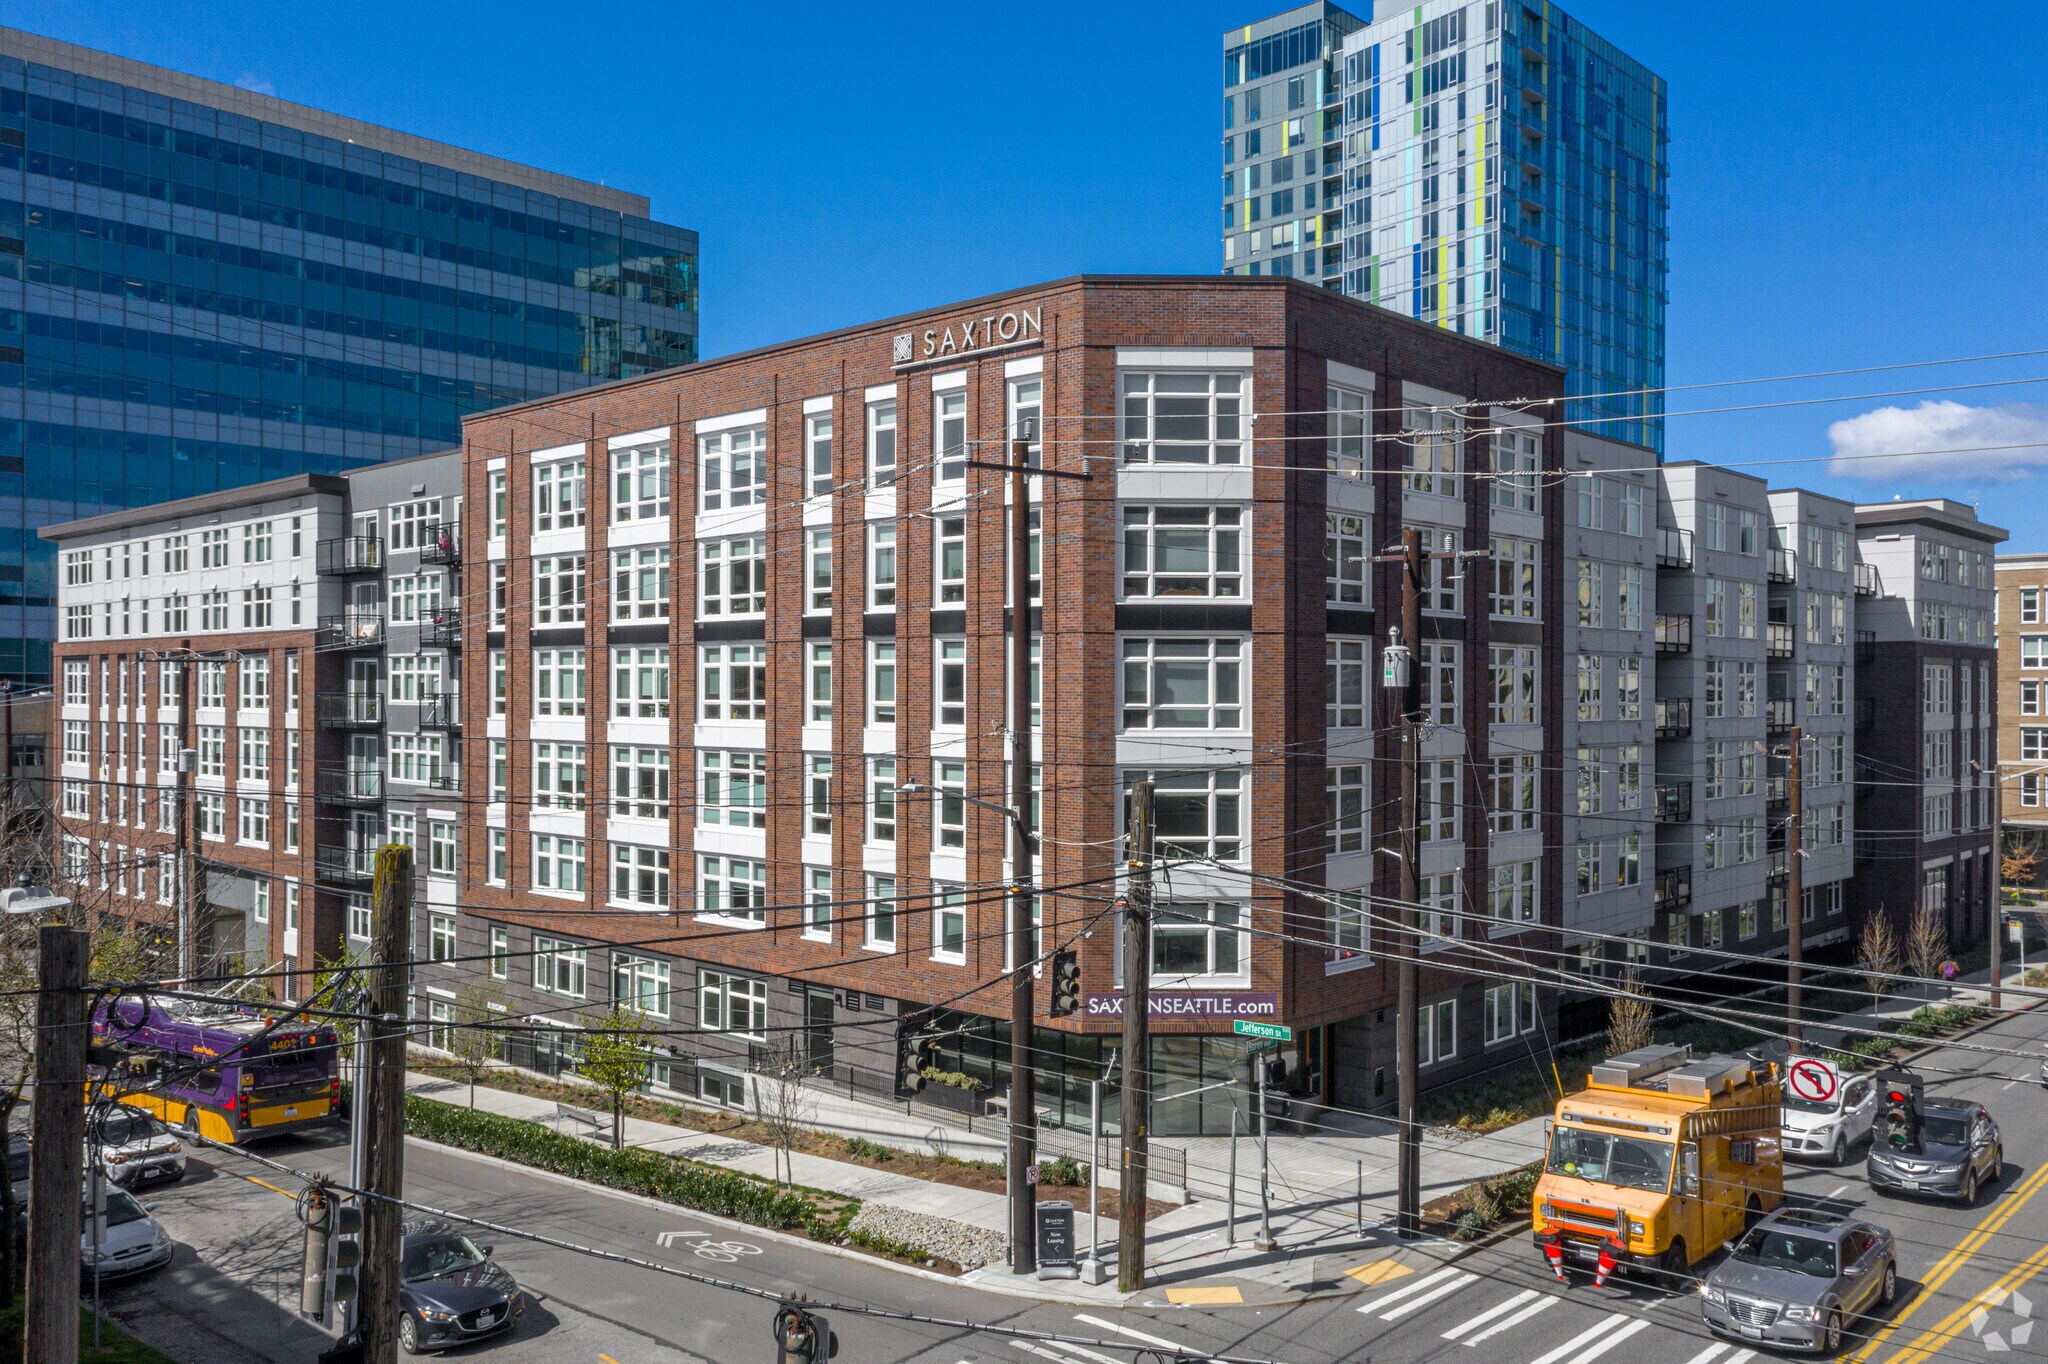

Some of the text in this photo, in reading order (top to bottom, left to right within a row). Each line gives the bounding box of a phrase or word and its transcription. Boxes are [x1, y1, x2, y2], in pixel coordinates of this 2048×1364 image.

[923, 306, 1043, 356] SAXTON
[1088, 997, 1274, 1014] SAXNSEATTLE.com
[1240, 1022, 1274, 1036] Jefferson
[1275, 1029, 1282, 1038] St
[310, 1035, 316, 1045] 3
[1248, 1040, 1263, 1052] Boren
